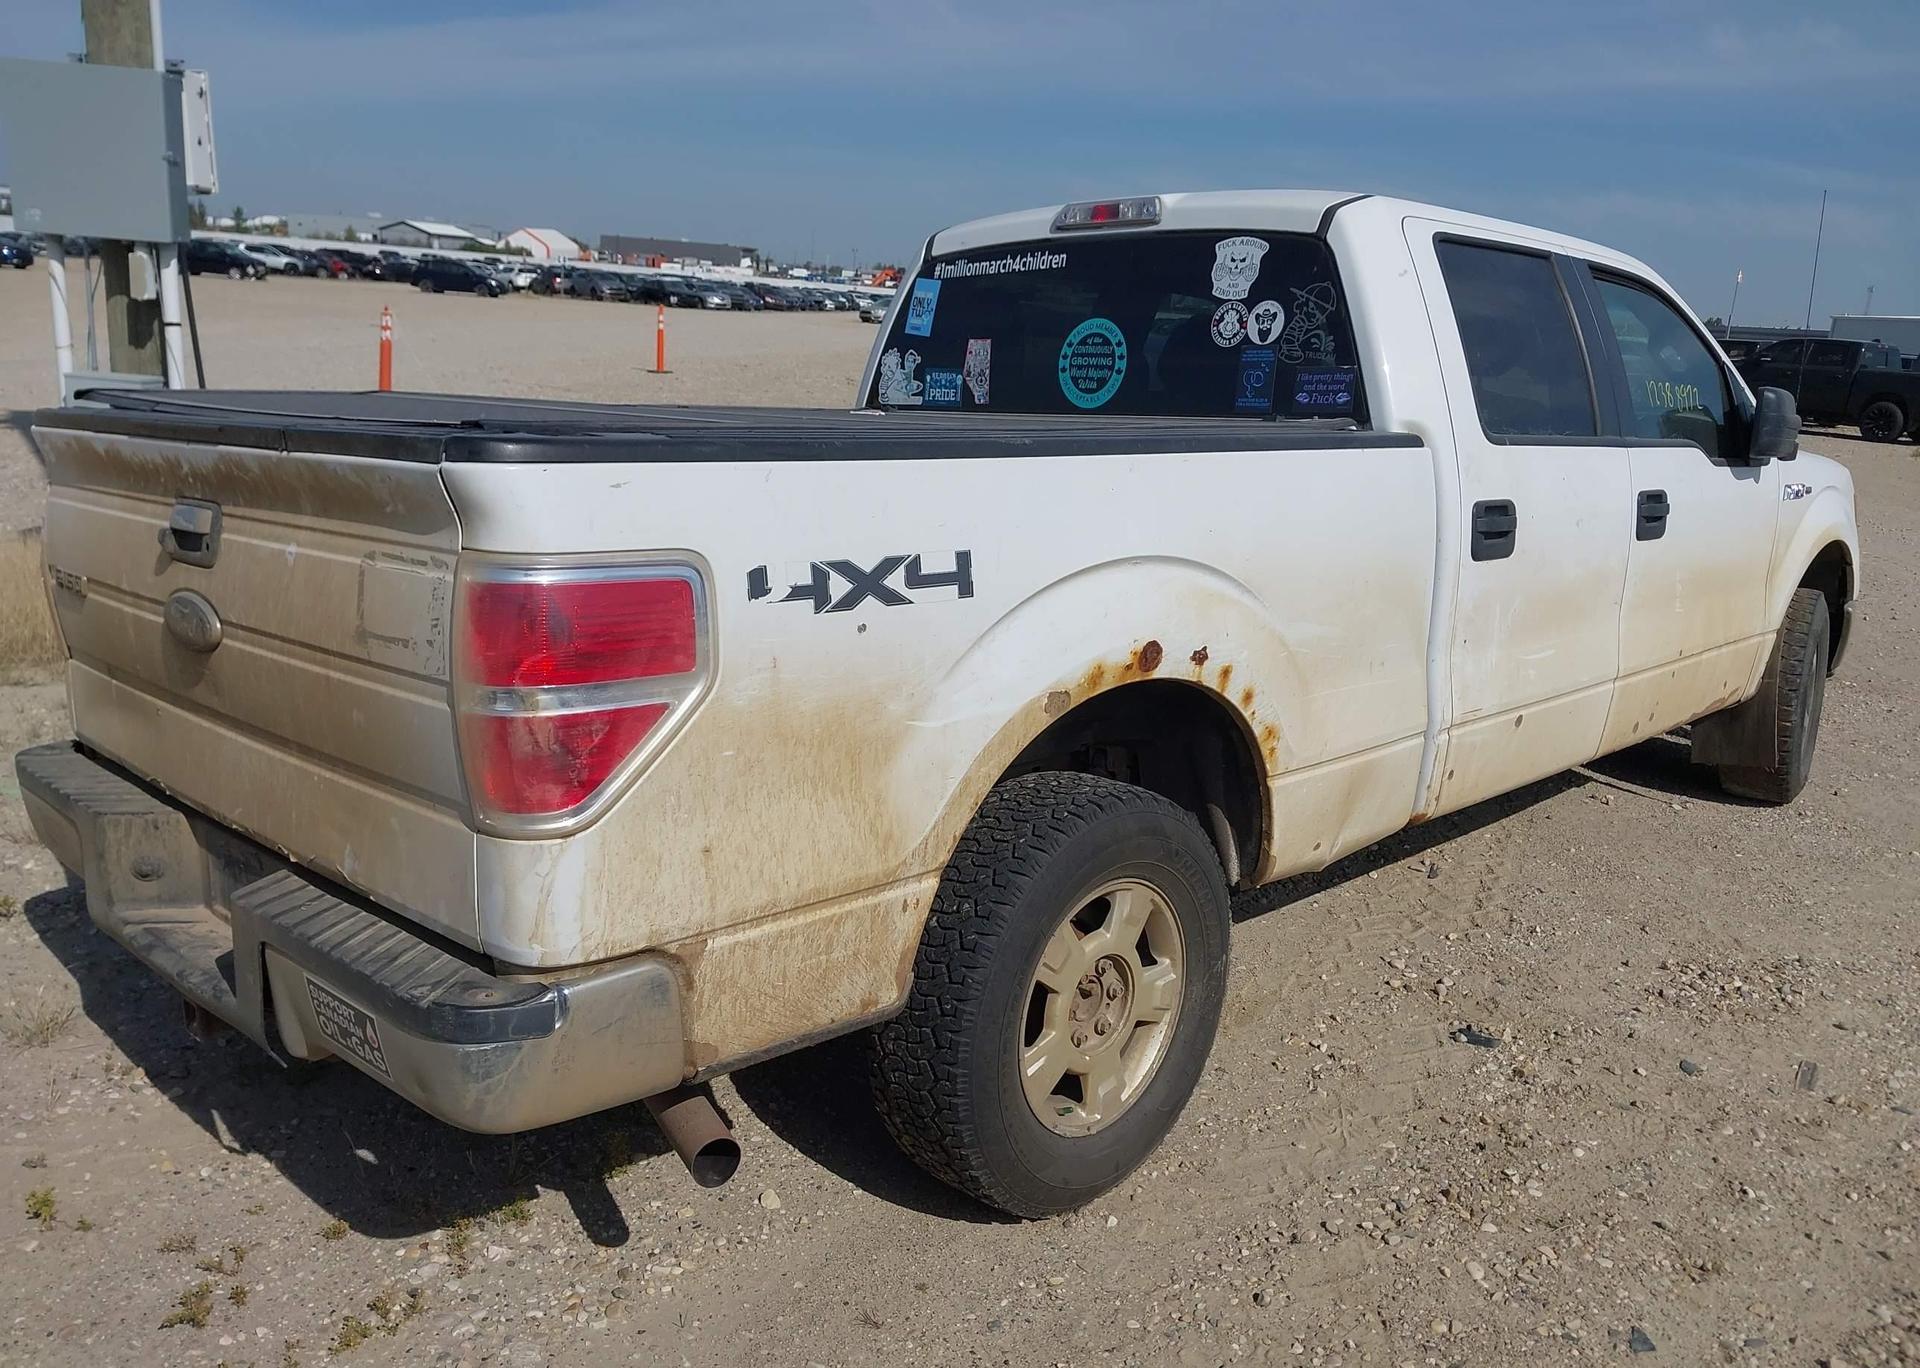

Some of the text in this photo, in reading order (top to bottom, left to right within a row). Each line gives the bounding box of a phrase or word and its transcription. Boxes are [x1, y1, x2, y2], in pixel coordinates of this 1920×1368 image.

[1217, 238, 1268, 252] FUCK AROUND
[934, 251, 1067, 279] #1millionmarch4children
[1214, 286, 1248, 298] FIND OUT
[912, 296, 933, 309] ONLY
[1071, 357, 1113, 366] GROWING
[1303, 383, 1316, 391] and
[1327, 383, 1346, 391] word
[929, 388, 957, 401] PRIDE
[1310, 392, 1335, 404] Fuck
[309, 984, 355, 1022] SUPPORT
[313, 999, 365, 1040] CANADIAN
[319, 1015, 347, 1046] OIL
[351, 1036, 387, 1071] GAS
